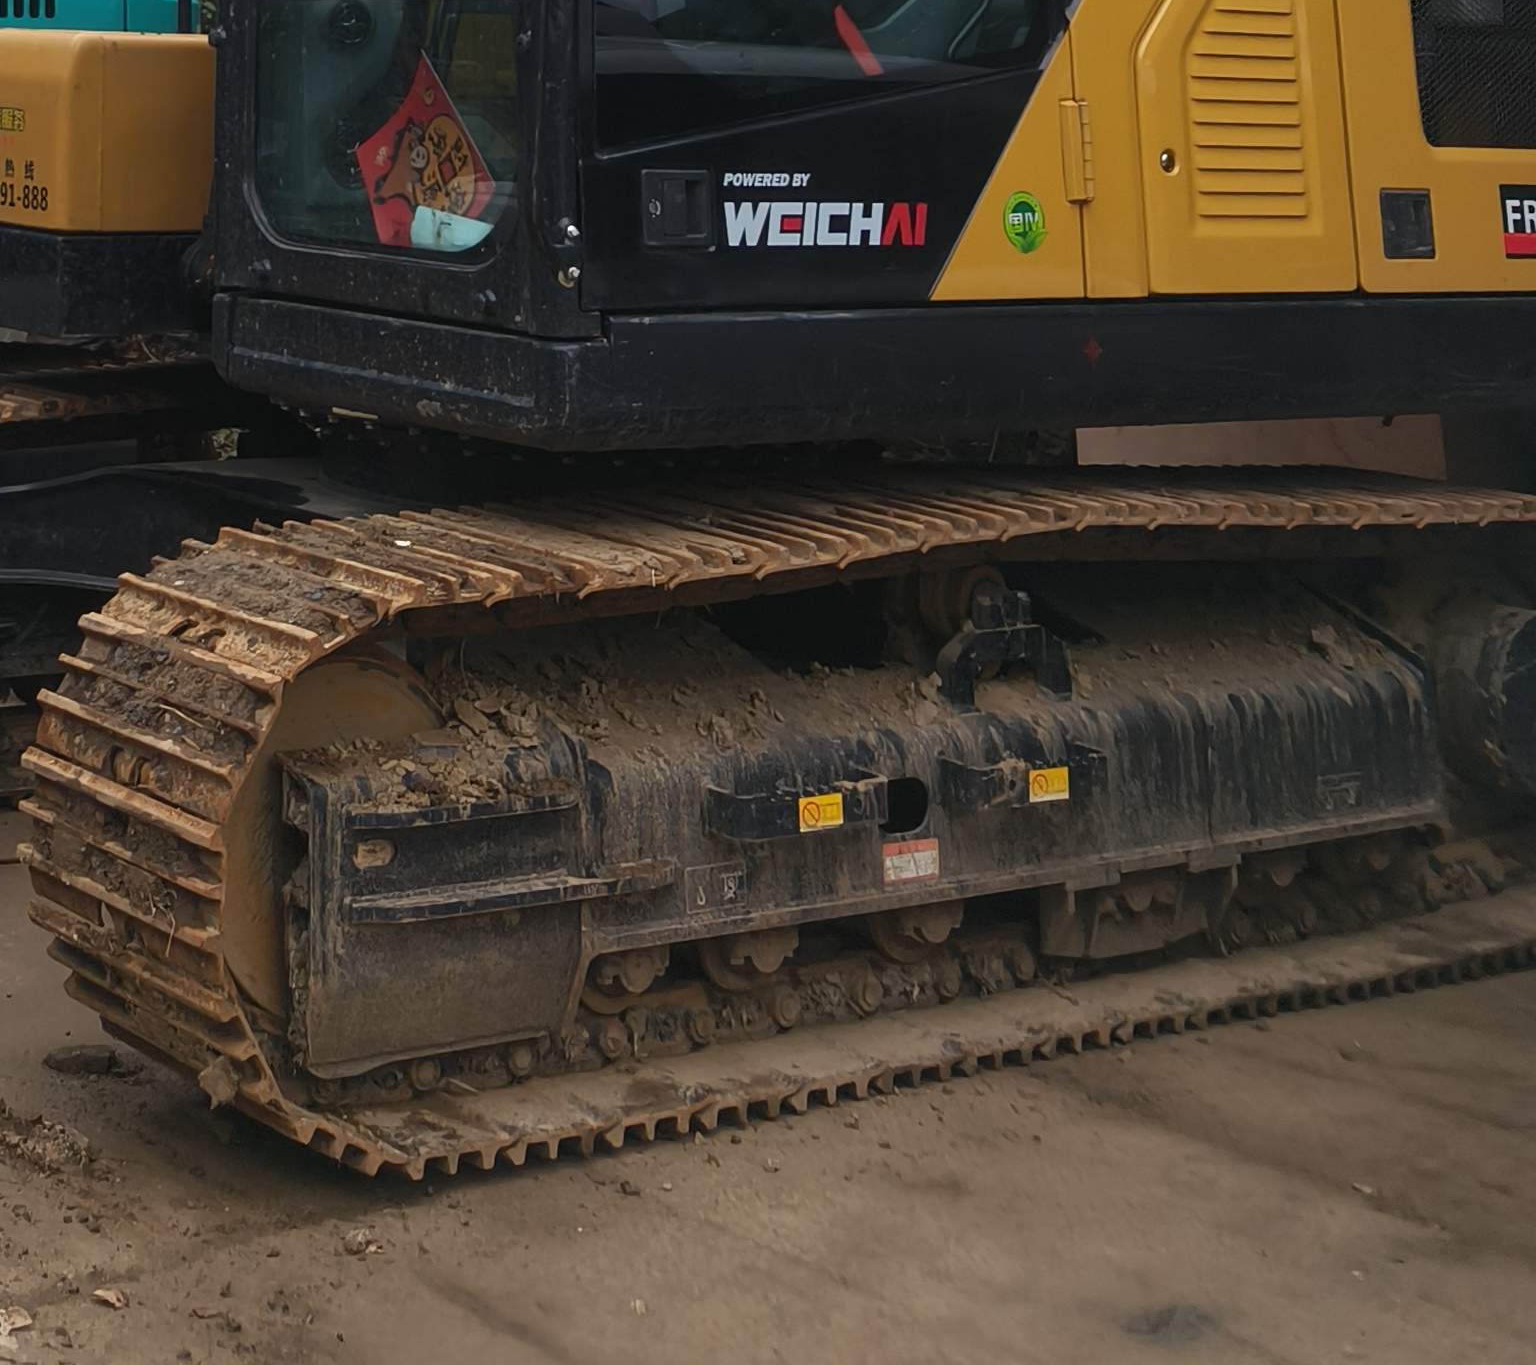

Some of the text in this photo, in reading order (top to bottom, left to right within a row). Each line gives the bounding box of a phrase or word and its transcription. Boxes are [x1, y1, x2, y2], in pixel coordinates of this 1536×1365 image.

[723, 173, 810, 187] POWERED BY
[723, 201, 928, 247] WEICHAI
